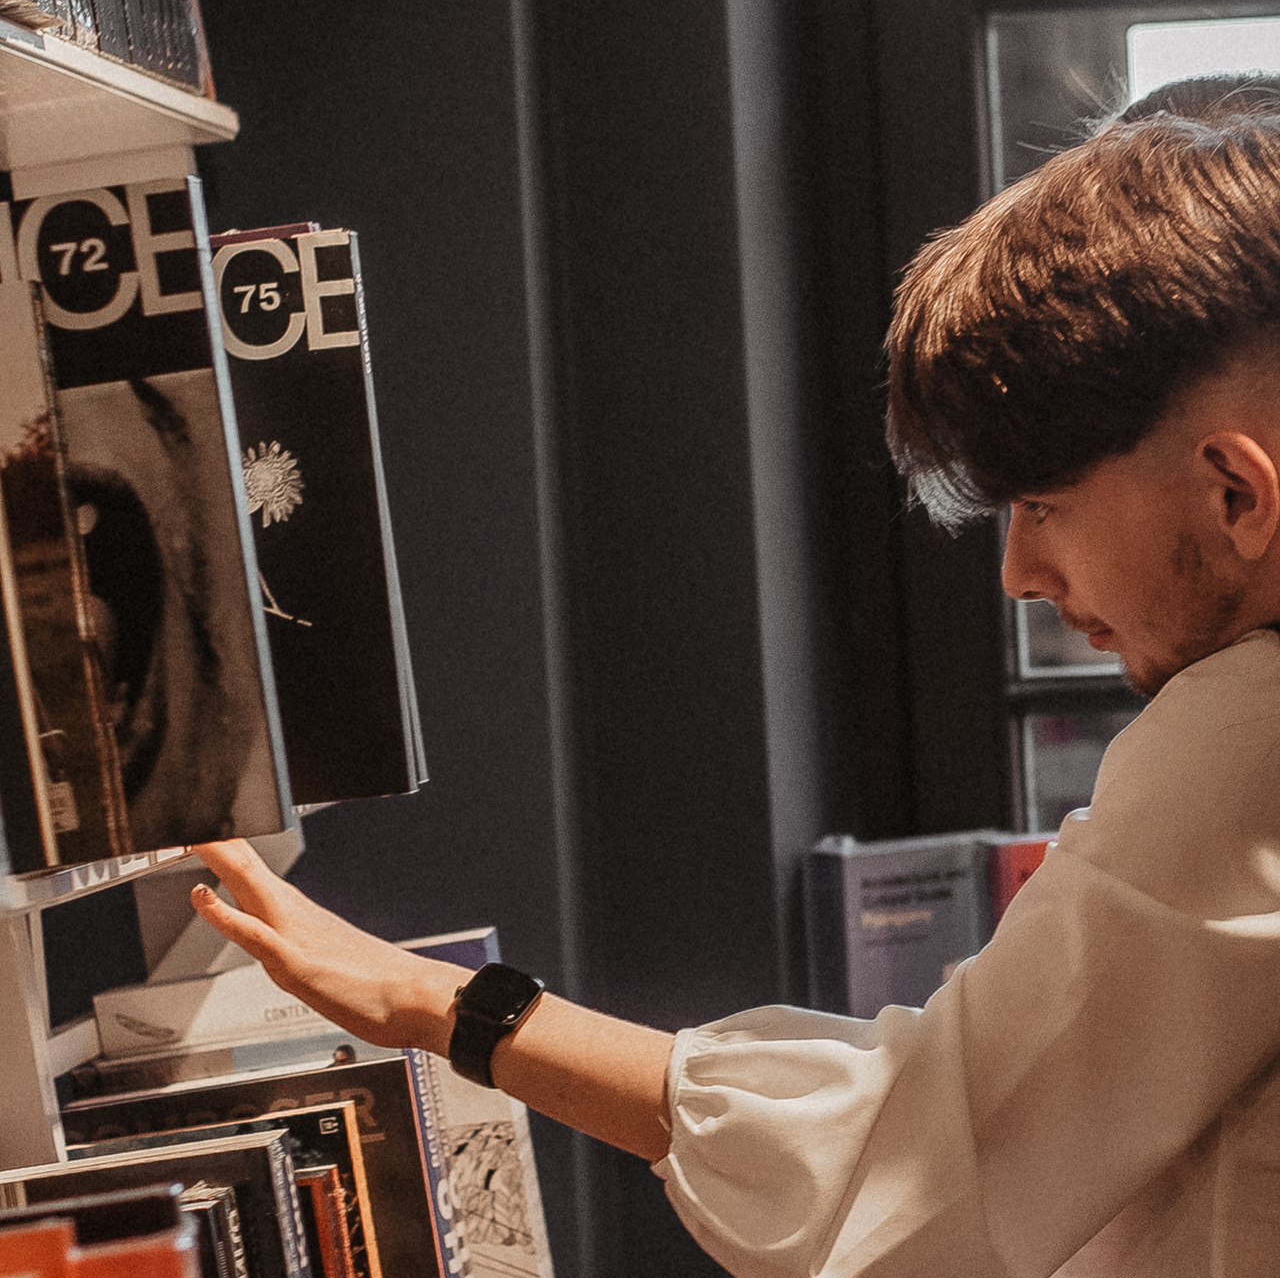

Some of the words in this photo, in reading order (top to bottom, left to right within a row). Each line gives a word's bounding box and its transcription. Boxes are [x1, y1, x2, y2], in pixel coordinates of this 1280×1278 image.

[0, 179, 205, 331] CE
[50, 237, 109, 276] 72
[233, 283, 281, 314] 75
